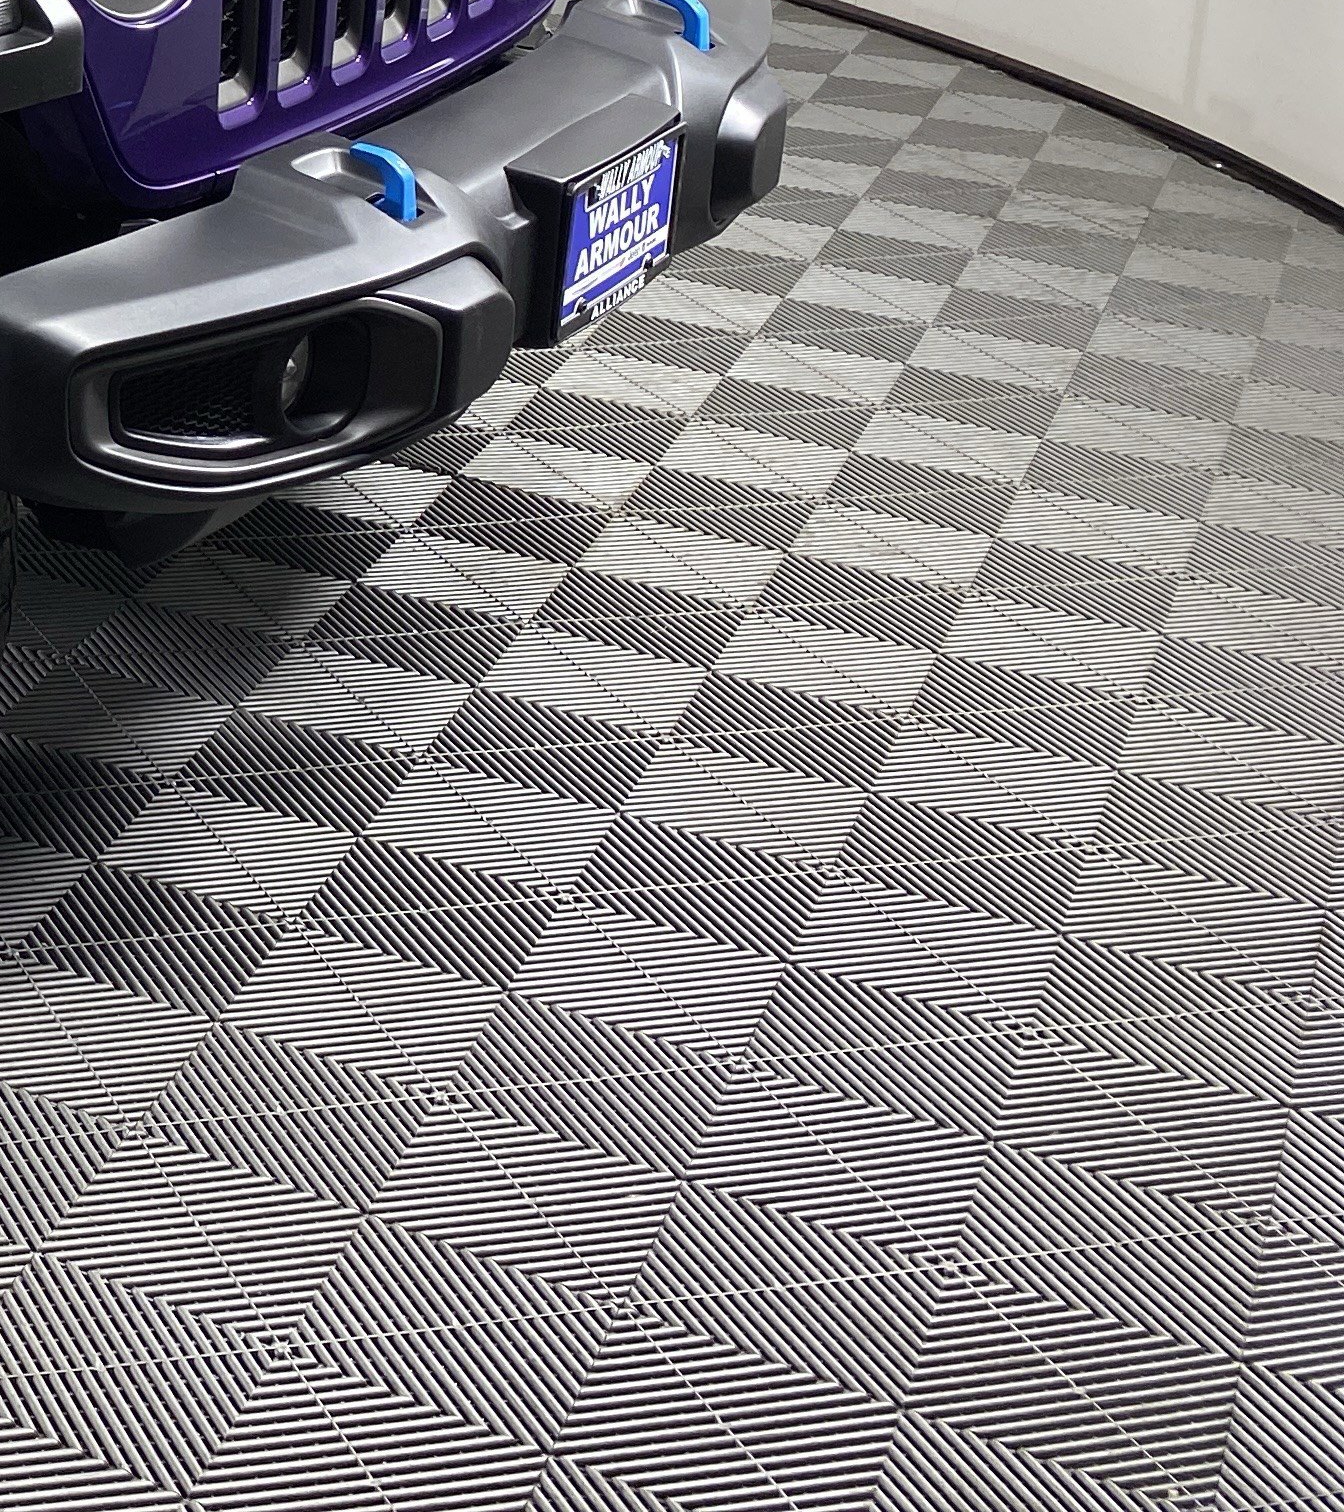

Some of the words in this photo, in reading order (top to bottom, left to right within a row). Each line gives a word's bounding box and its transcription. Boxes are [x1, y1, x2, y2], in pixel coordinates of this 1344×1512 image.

[588, 173, 656, 240] WALLY
[573, 202, 661, 283] ARMOUR
[590, 273, 647, 321] ALLIANCE
